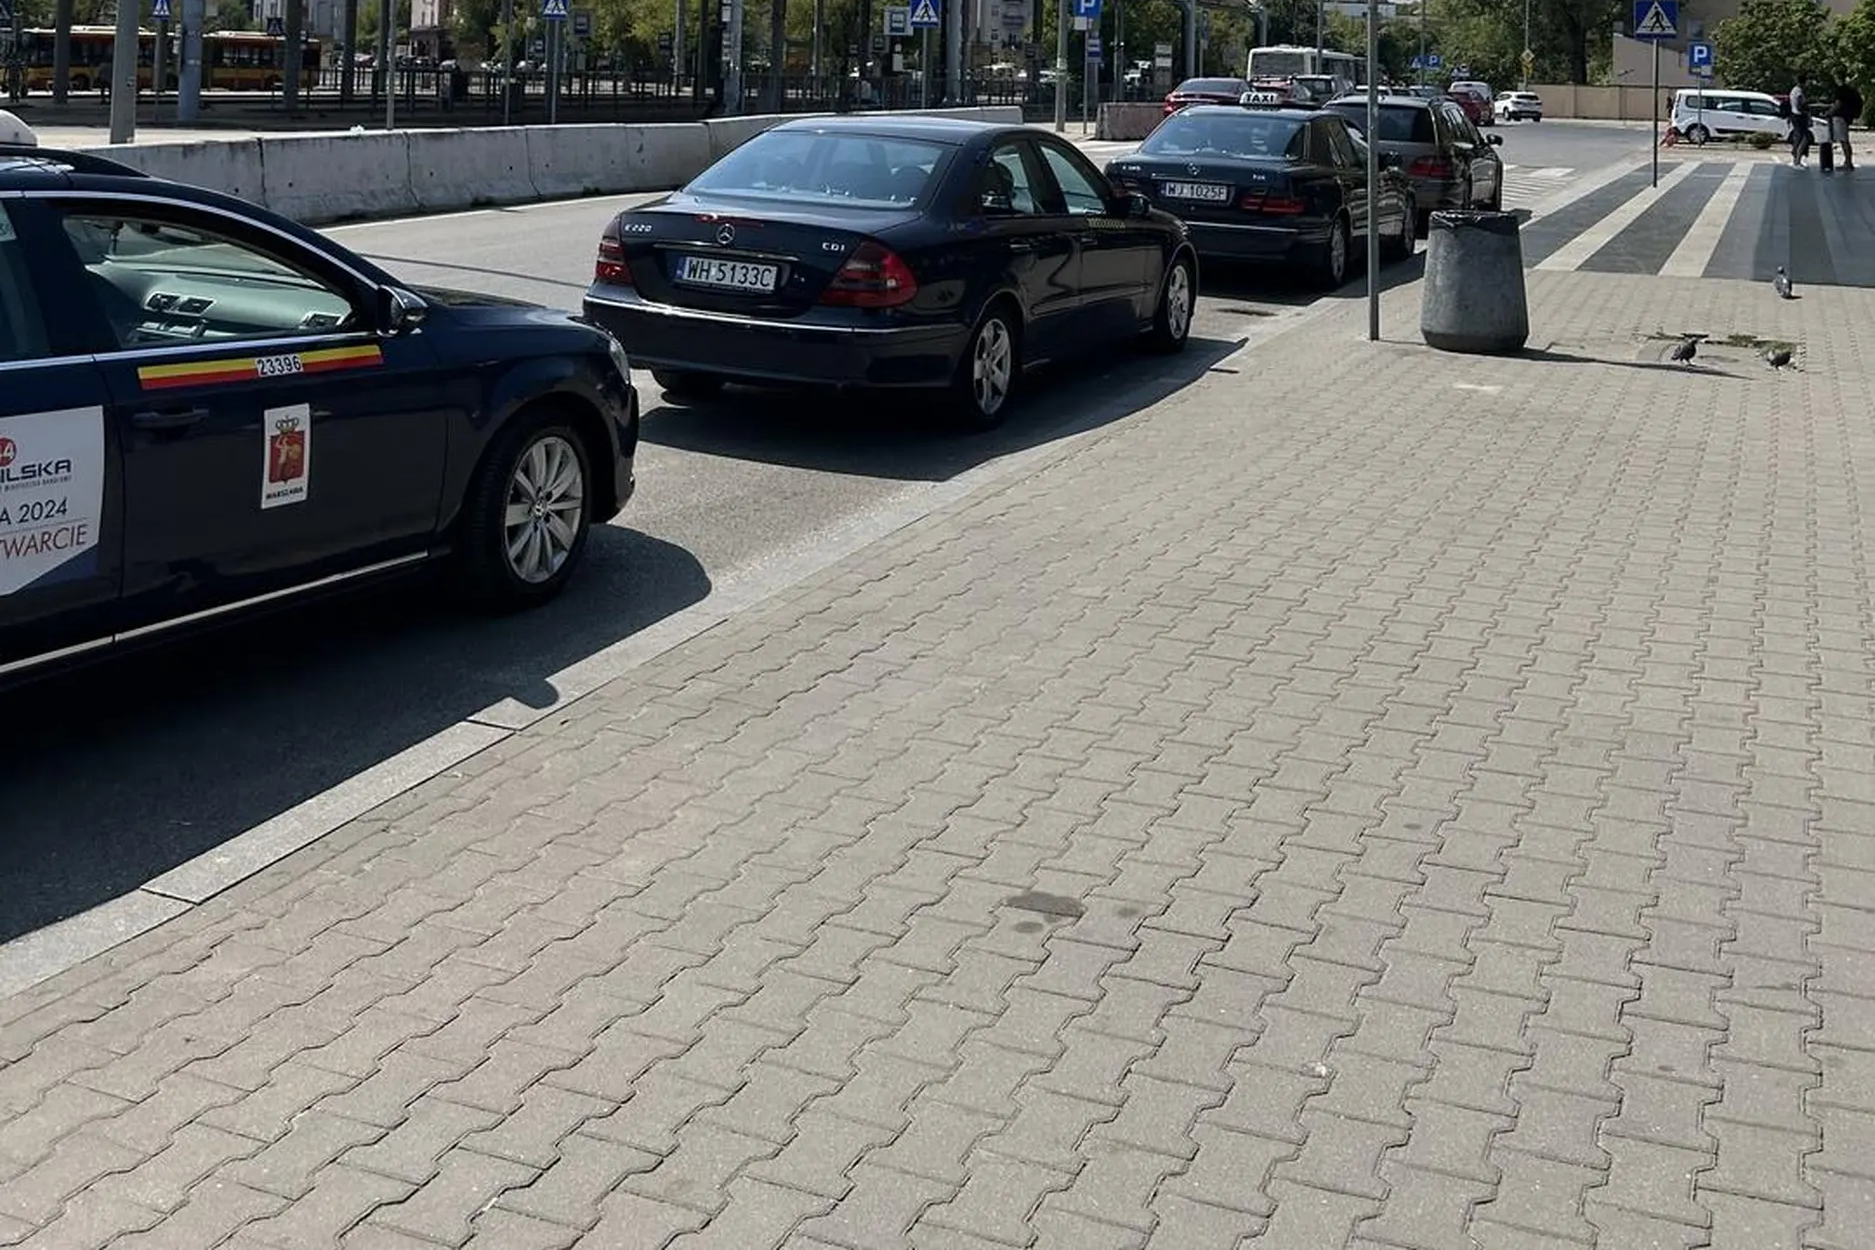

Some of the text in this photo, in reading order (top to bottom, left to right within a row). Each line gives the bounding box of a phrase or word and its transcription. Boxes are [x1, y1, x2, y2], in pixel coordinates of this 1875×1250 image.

[1694, 45, 1708, 62] P
[1245, 93, 1275, 103] TAXI
[822, 242, 845, 251] CDI
[687, 258, 772, 287] WH 5133C
[257, 355, 301, 375] 23396
[18, 496, 67, 523] 2024
